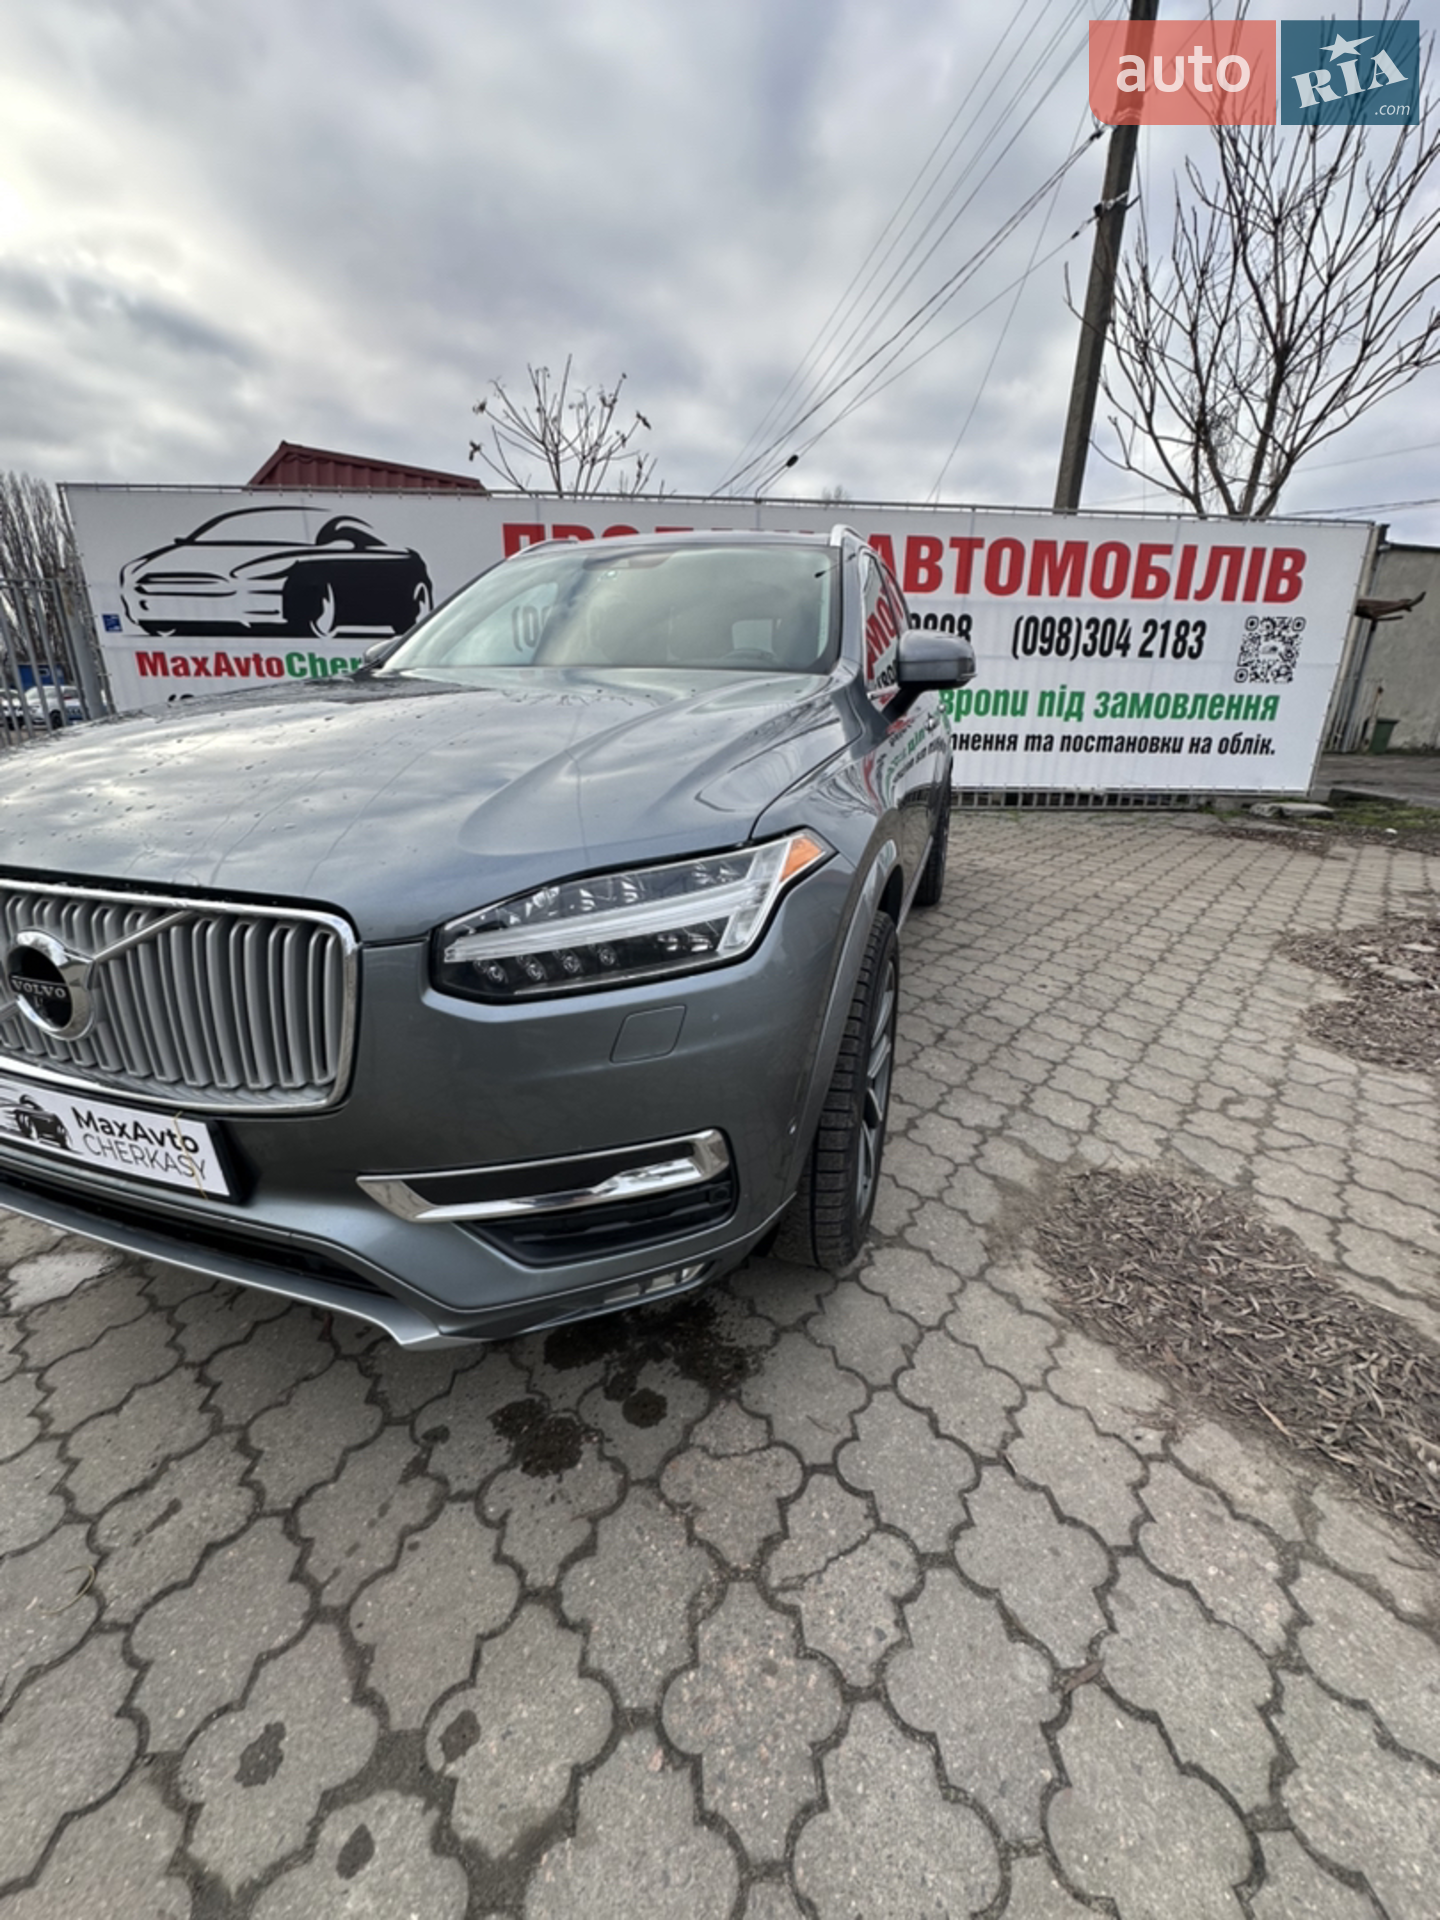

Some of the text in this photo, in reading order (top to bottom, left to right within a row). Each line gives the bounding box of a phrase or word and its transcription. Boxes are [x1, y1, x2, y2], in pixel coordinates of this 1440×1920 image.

[1012, 615, 1131, 661] (098)304
[1138, 618, 1207, 660] 2183
[1037, 684, 1085, 722] під
[1094, 690, 1280, 721] замовлення
[1024, 733, 1054, 752] та
[1060, 733, 1182, 755] постановки
[1189, 735, 1212, 755] на
[1218, 732, 1276, 755] облік.
[11, 979, 67, 999] VOLVO
[71, 1106, 200, 1154] MaxAvto
[81, 1133, 206, 1180] CHERKASY
